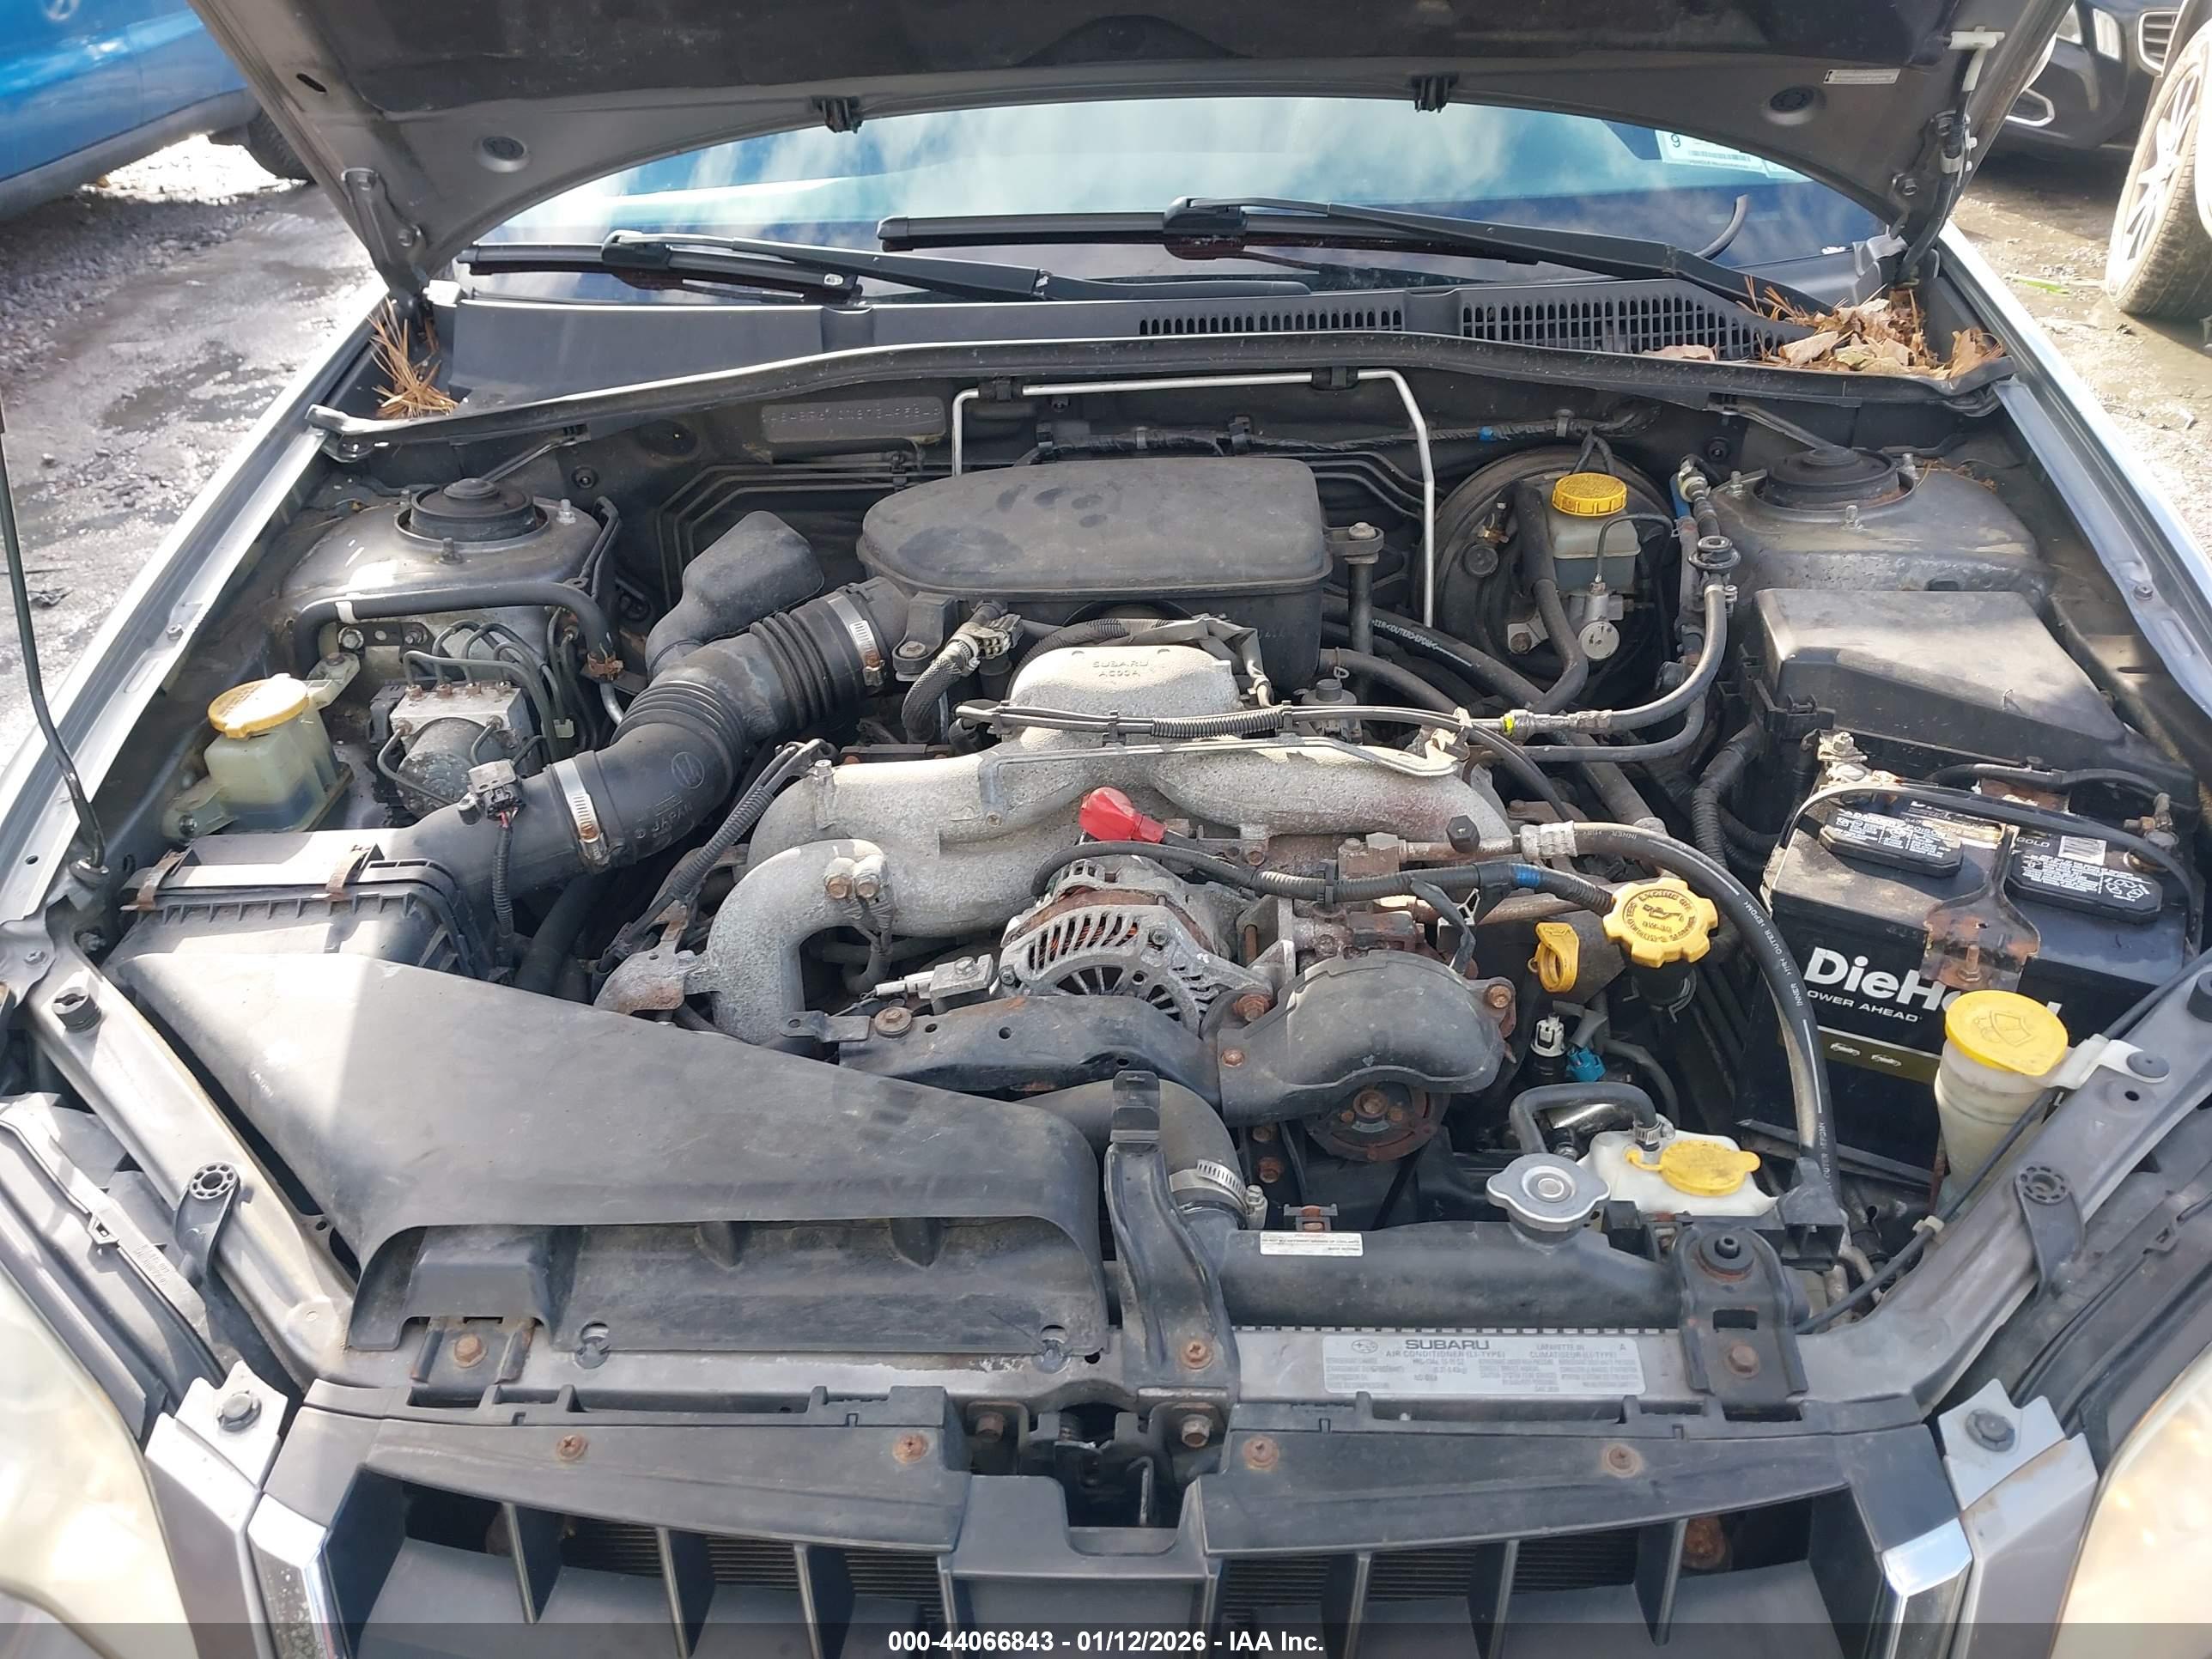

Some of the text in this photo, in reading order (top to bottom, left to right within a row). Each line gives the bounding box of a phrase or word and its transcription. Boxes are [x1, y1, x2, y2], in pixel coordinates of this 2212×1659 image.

[1092, 659, 1149, 668] SUBARU
[2015, 836, 2051, 848] GOLD
[1763, 927, 1783, 956] OUTER
[1790, 981, 1804, 1007] INNER
[1807, 989, 1918, 1024] OWER AHEAD
[1405, 1339, 1491, 1350] SUBARU
[1403, 1350, 1463, 1358] CONDITIONER
